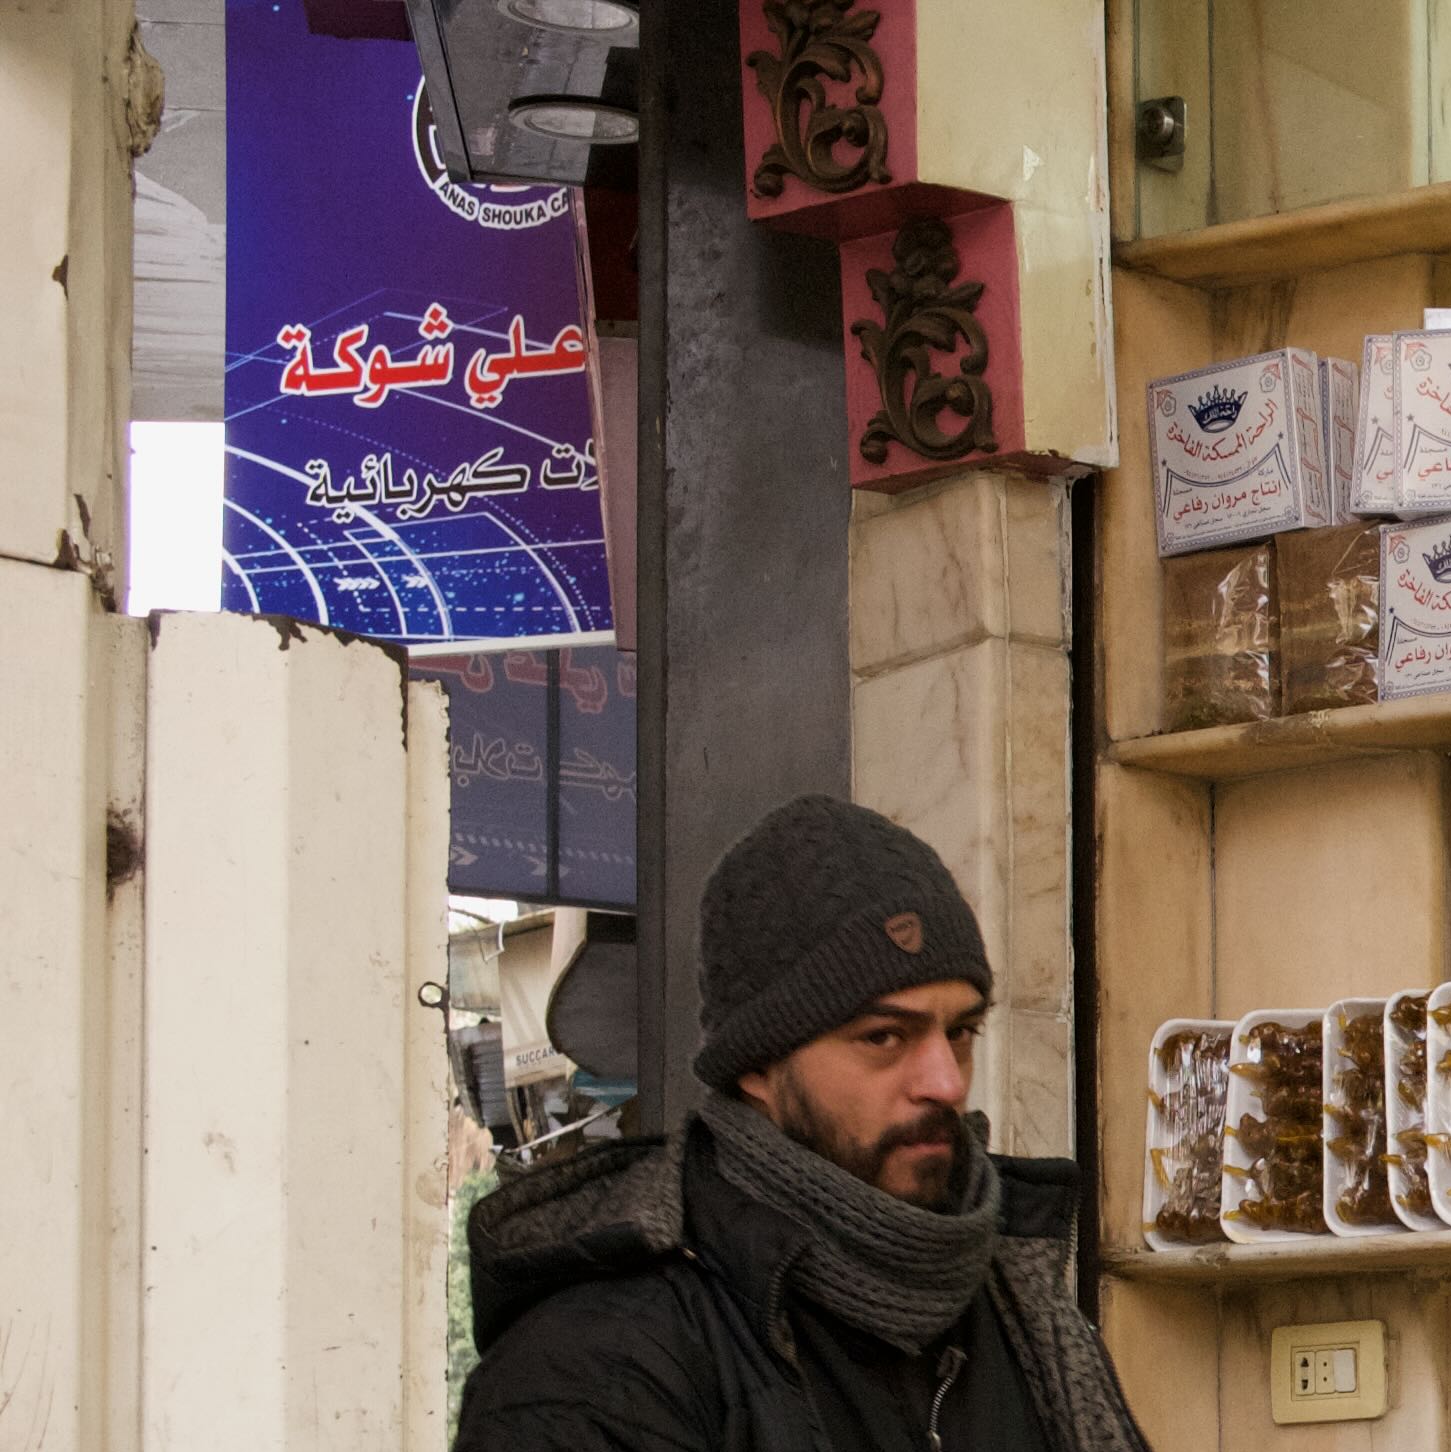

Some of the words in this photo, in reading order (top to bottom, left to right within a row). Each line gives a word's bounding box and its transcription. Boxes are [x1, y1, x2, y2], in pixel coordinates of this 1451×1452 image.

[439, 182, 475, 216] ANAS
[481, 205, 547, 226] SHOUKA
[278, 303, 454, 408] شوكة
[466, 316, 587, 408] علي
[305, 449, 530, 521] كهربائية
[1395, 646, 1432, 672] رفاعي
